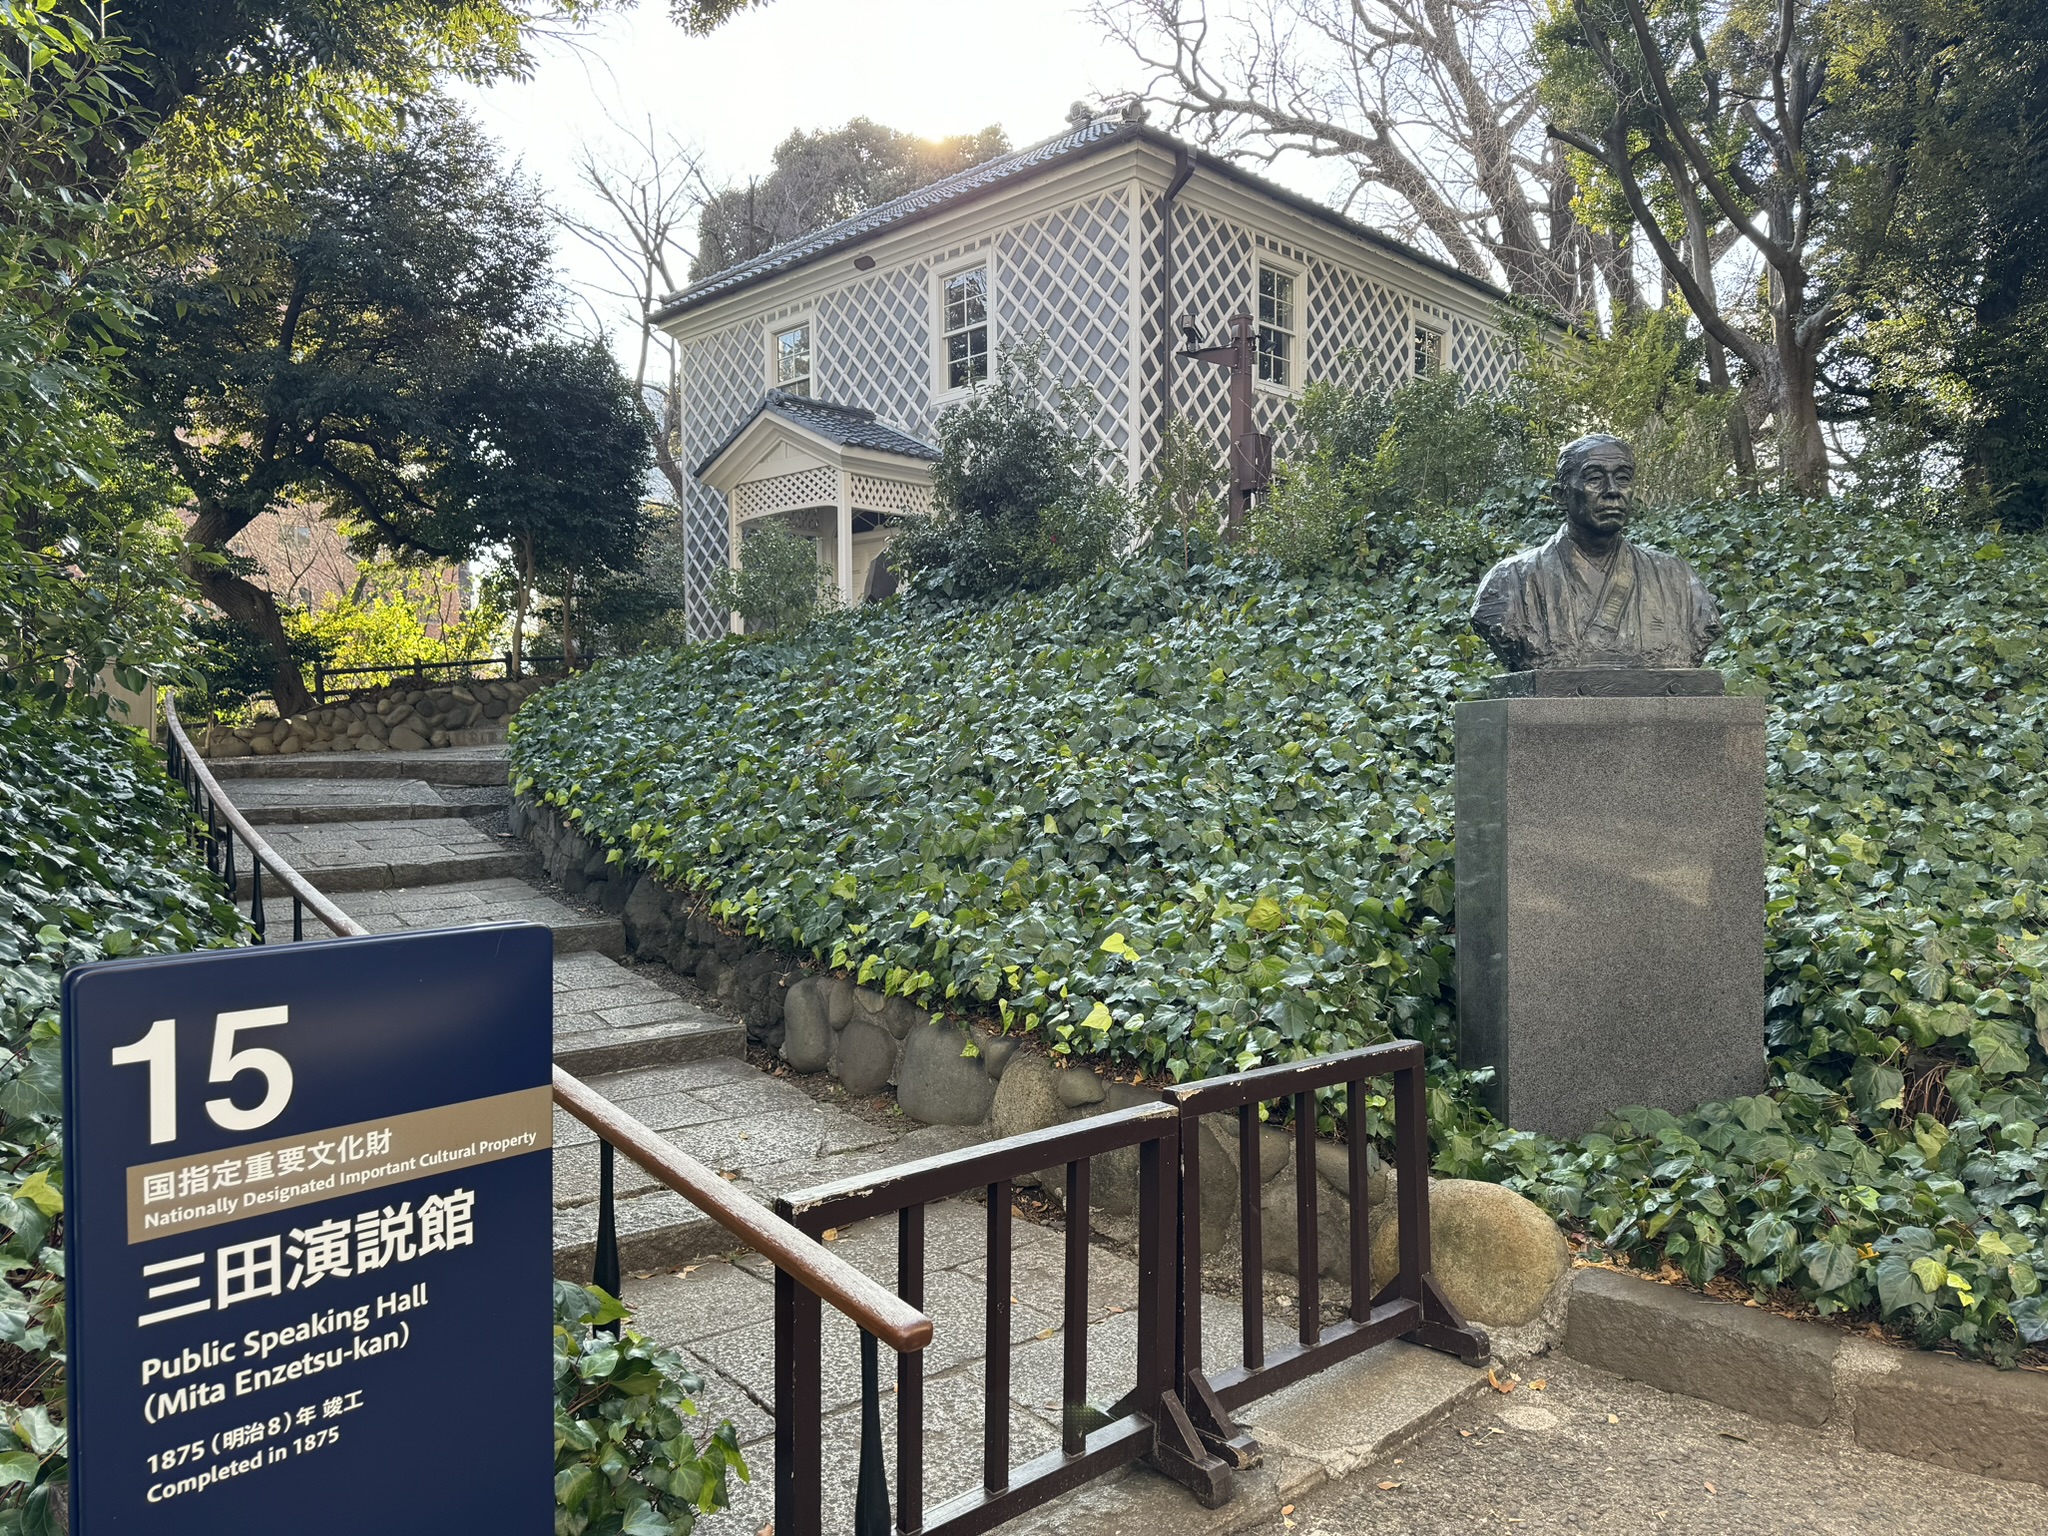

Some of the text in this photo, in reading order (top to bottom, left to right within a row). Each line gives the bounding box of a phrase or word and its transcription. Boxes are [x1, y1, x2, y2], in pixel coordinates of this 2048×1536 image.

[112, 1004, 294, 1145] 15
[143, 1127, 392, 1205] 国指定重要文化財
[144, 1132, 538, 1229] Nationally Designated Important Cultural Property
[138, 1188, 475, 1328] 三田演説館
[142, 1282, 429, 1386] Public Speaking Hall
[144, 1320, 409, 1424] (Mita Enzetsu-kan)
[146, 1425, 340, 1503] Completed in 1875
